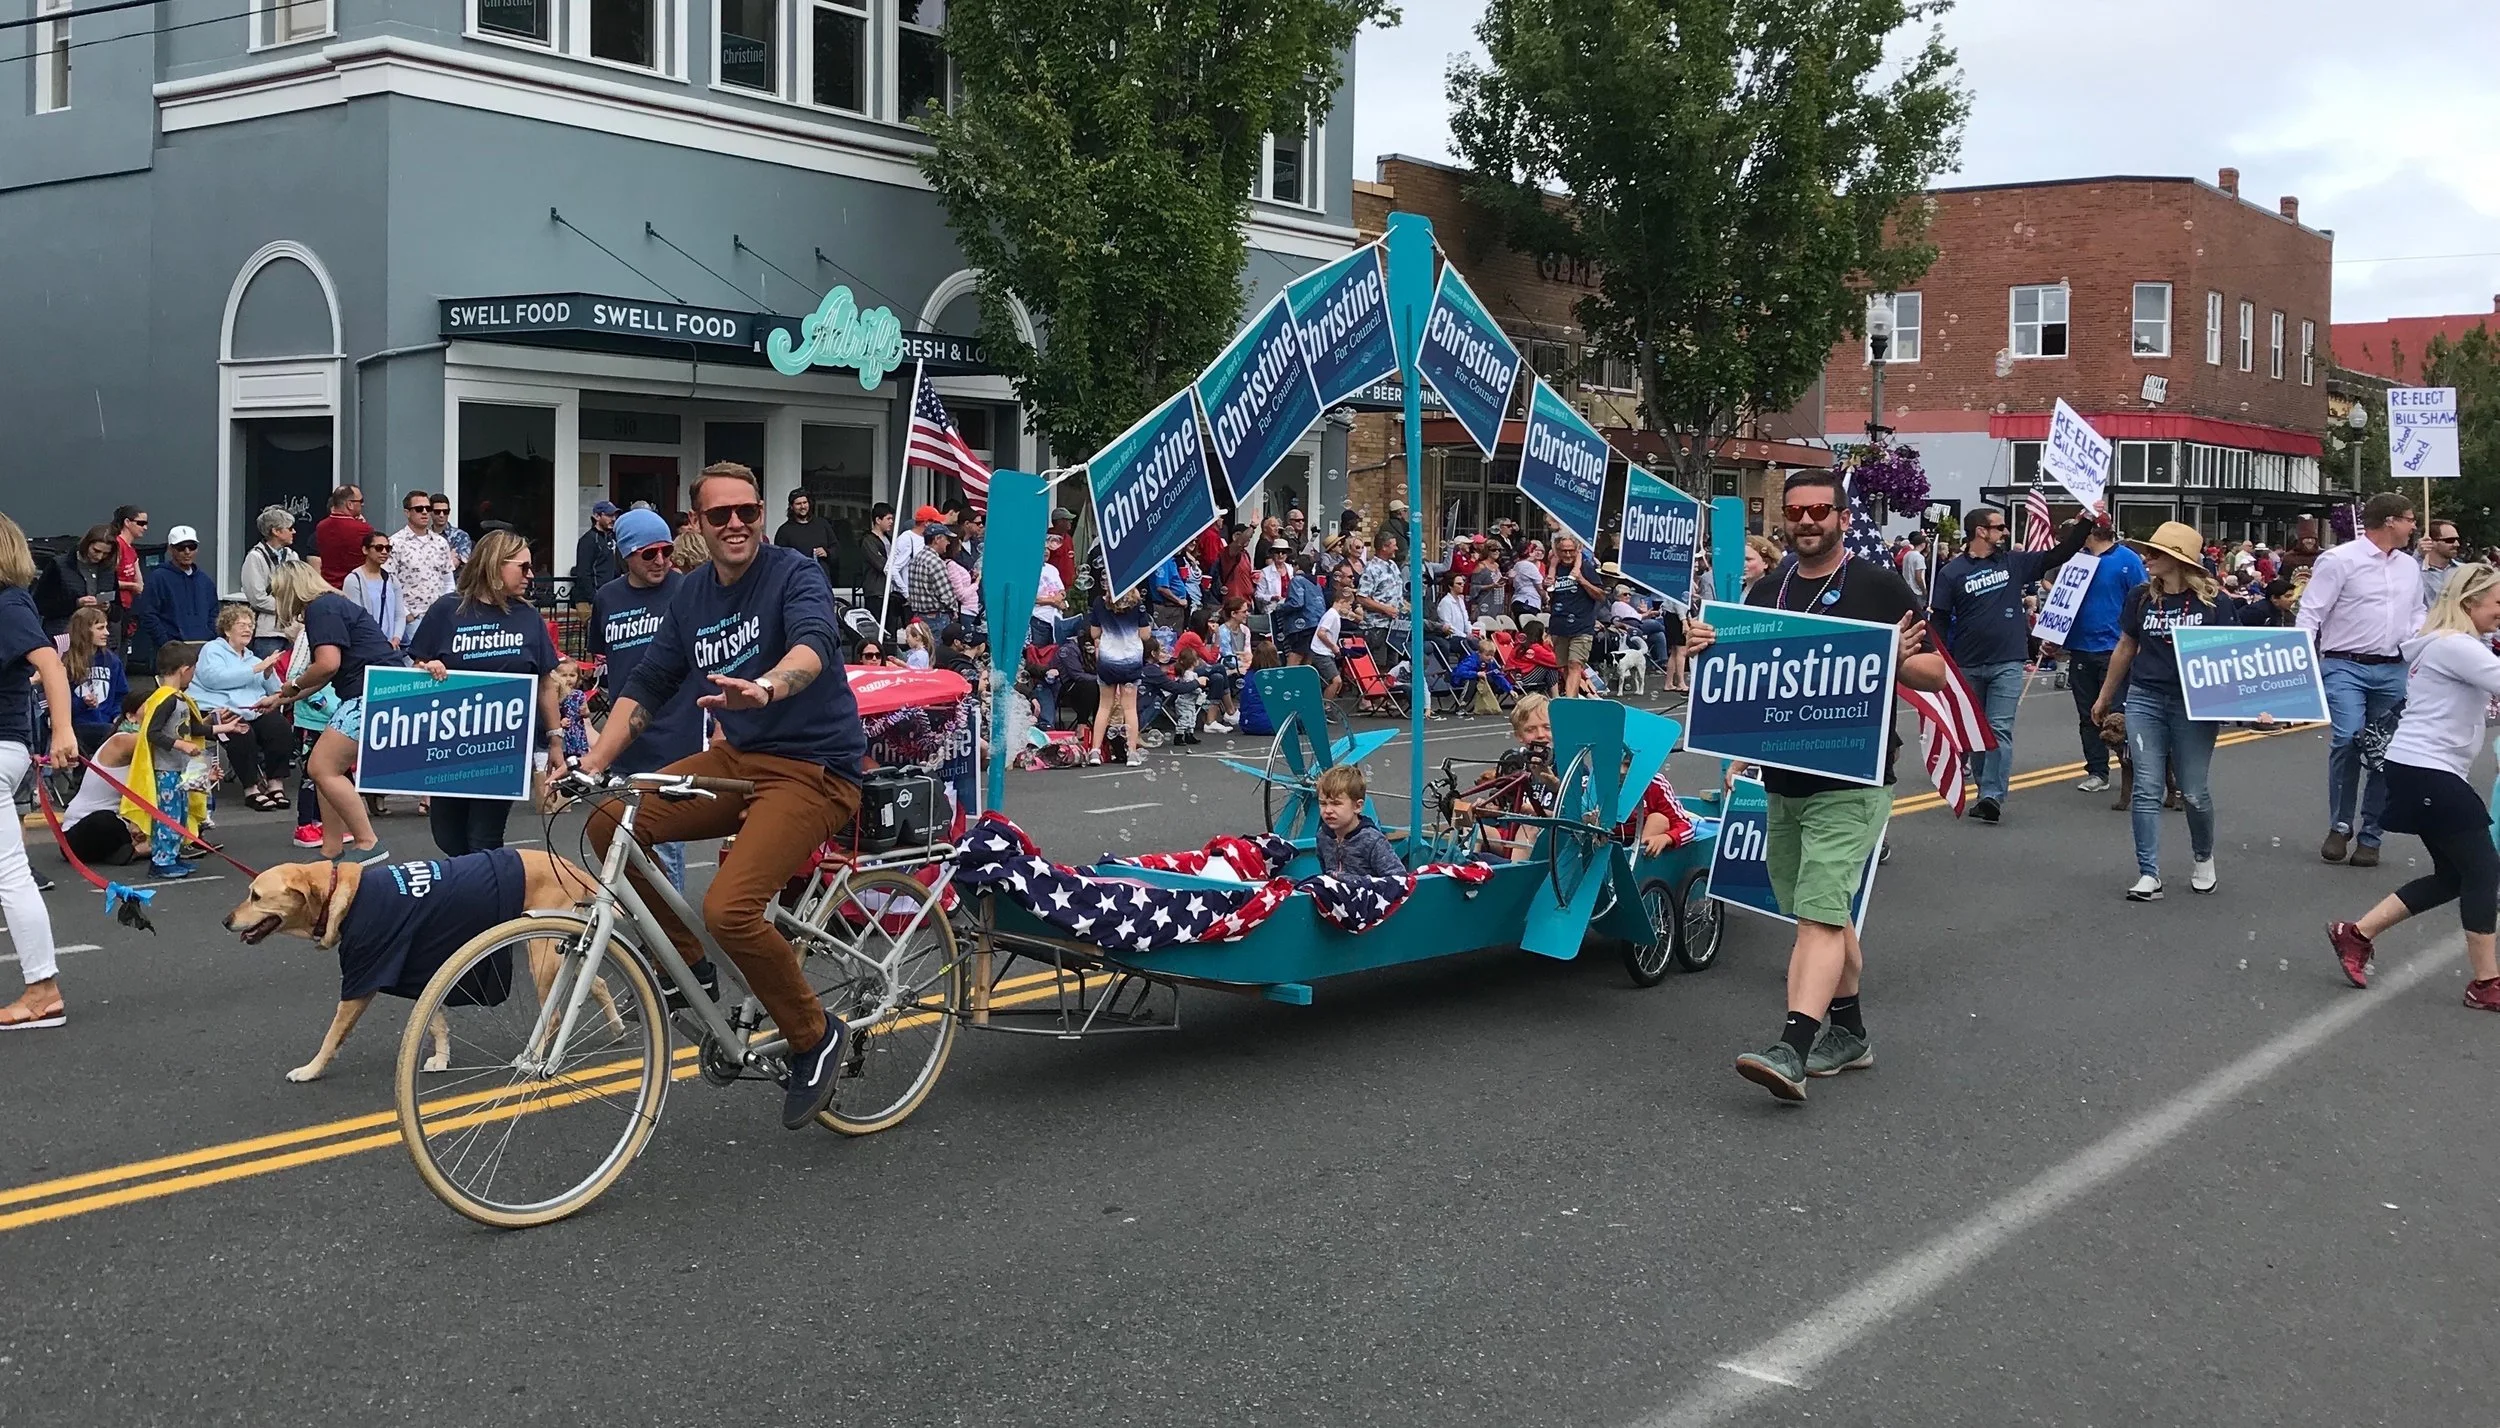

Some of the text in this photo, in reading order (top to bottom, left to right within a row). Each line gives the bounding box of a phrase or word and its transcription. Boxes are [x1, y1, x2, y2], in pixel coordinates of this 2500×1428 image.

[723, 46, 764, 65] Christine
[450, 302, 570, 327] SWELL FOOD
[593, 304, 736, 338] SWELL FOOD
[1300, 269, 1380, 366] Christine
[902, 339, 945, 360] RESH
[950, 344, 961, 361] &
[1334, 310, 1382, 365] For Council
[1431, 306, 1511, 394] Christine
[1217, 321, 1295, 459] Christine
[1257, 360, 1300, 437] For Council
[1373, 386, 1401, 401] BEER
[1454, 365, 1501, 409] For Council
[2391, 391, 2445, 406] RE-ELECT
[2396, 410, 2457, 425] BILL SHAW
[2056, 411, 2110, 470] RE-ELECT
[2392, 426, 2412, 454] School
[1121, 444, 1132, 467] Ward
[1529, 422, 1602, 486] Christine
[2403, 440, 2430, 471] Board
[1104, 418, 1195, 550] Christine
[1554, 473, 1567, 488] For
[1146, 460, 1198, 532] For Council
[1627, 504, 1695, 546] Christine
[1650, 547, 1688, 562] For Council
[1965, 570, 2010, 593] Christine
[2060, 565, 2089, 589] KEEP
[2050, 587, 2073, 610] BILL
[605, 613, 664, 644] Christin
[1714, 621, 1783, 637] nacortes Ward 2
[2038, 610, 2072, 633] ONBOARD
[2142, 612, 2203, 630] Christine
[452, 630, 524, 653] Christine
[1701, 643, 1881, 704] Christine
[2187, 642, 2308, 689] Christine
[373, 684, 411, 696] Anacortes
[413, 679, 433, 690] Ward
[2238, 673, 2308, 696] For Council
[369, 693, 524, 751] Christine
[1763, 701, 1869, 723] For Council
[426, 735, 515, 762] For Council
[938, 763, 969, 778] ouncil
